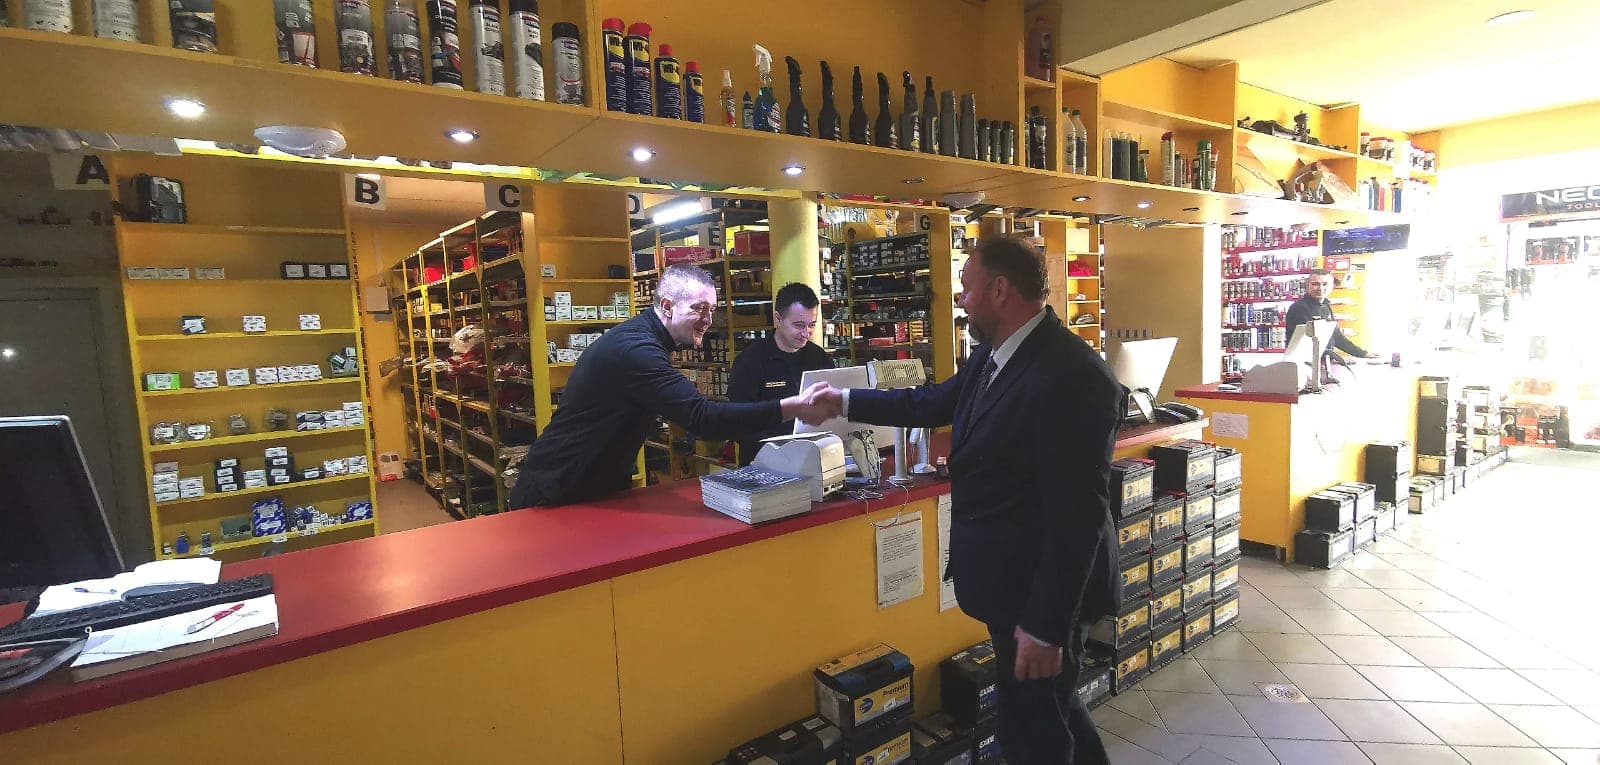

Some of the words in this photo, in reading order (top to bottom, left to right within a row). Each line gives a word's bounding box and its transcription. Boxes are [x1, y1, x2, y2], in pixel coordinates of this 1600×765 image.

[76, 155, 110, 184] A
[355, 178, 379, 204] B
[499, 185, 520, 207] C
[920, 215, 930, 230] G
